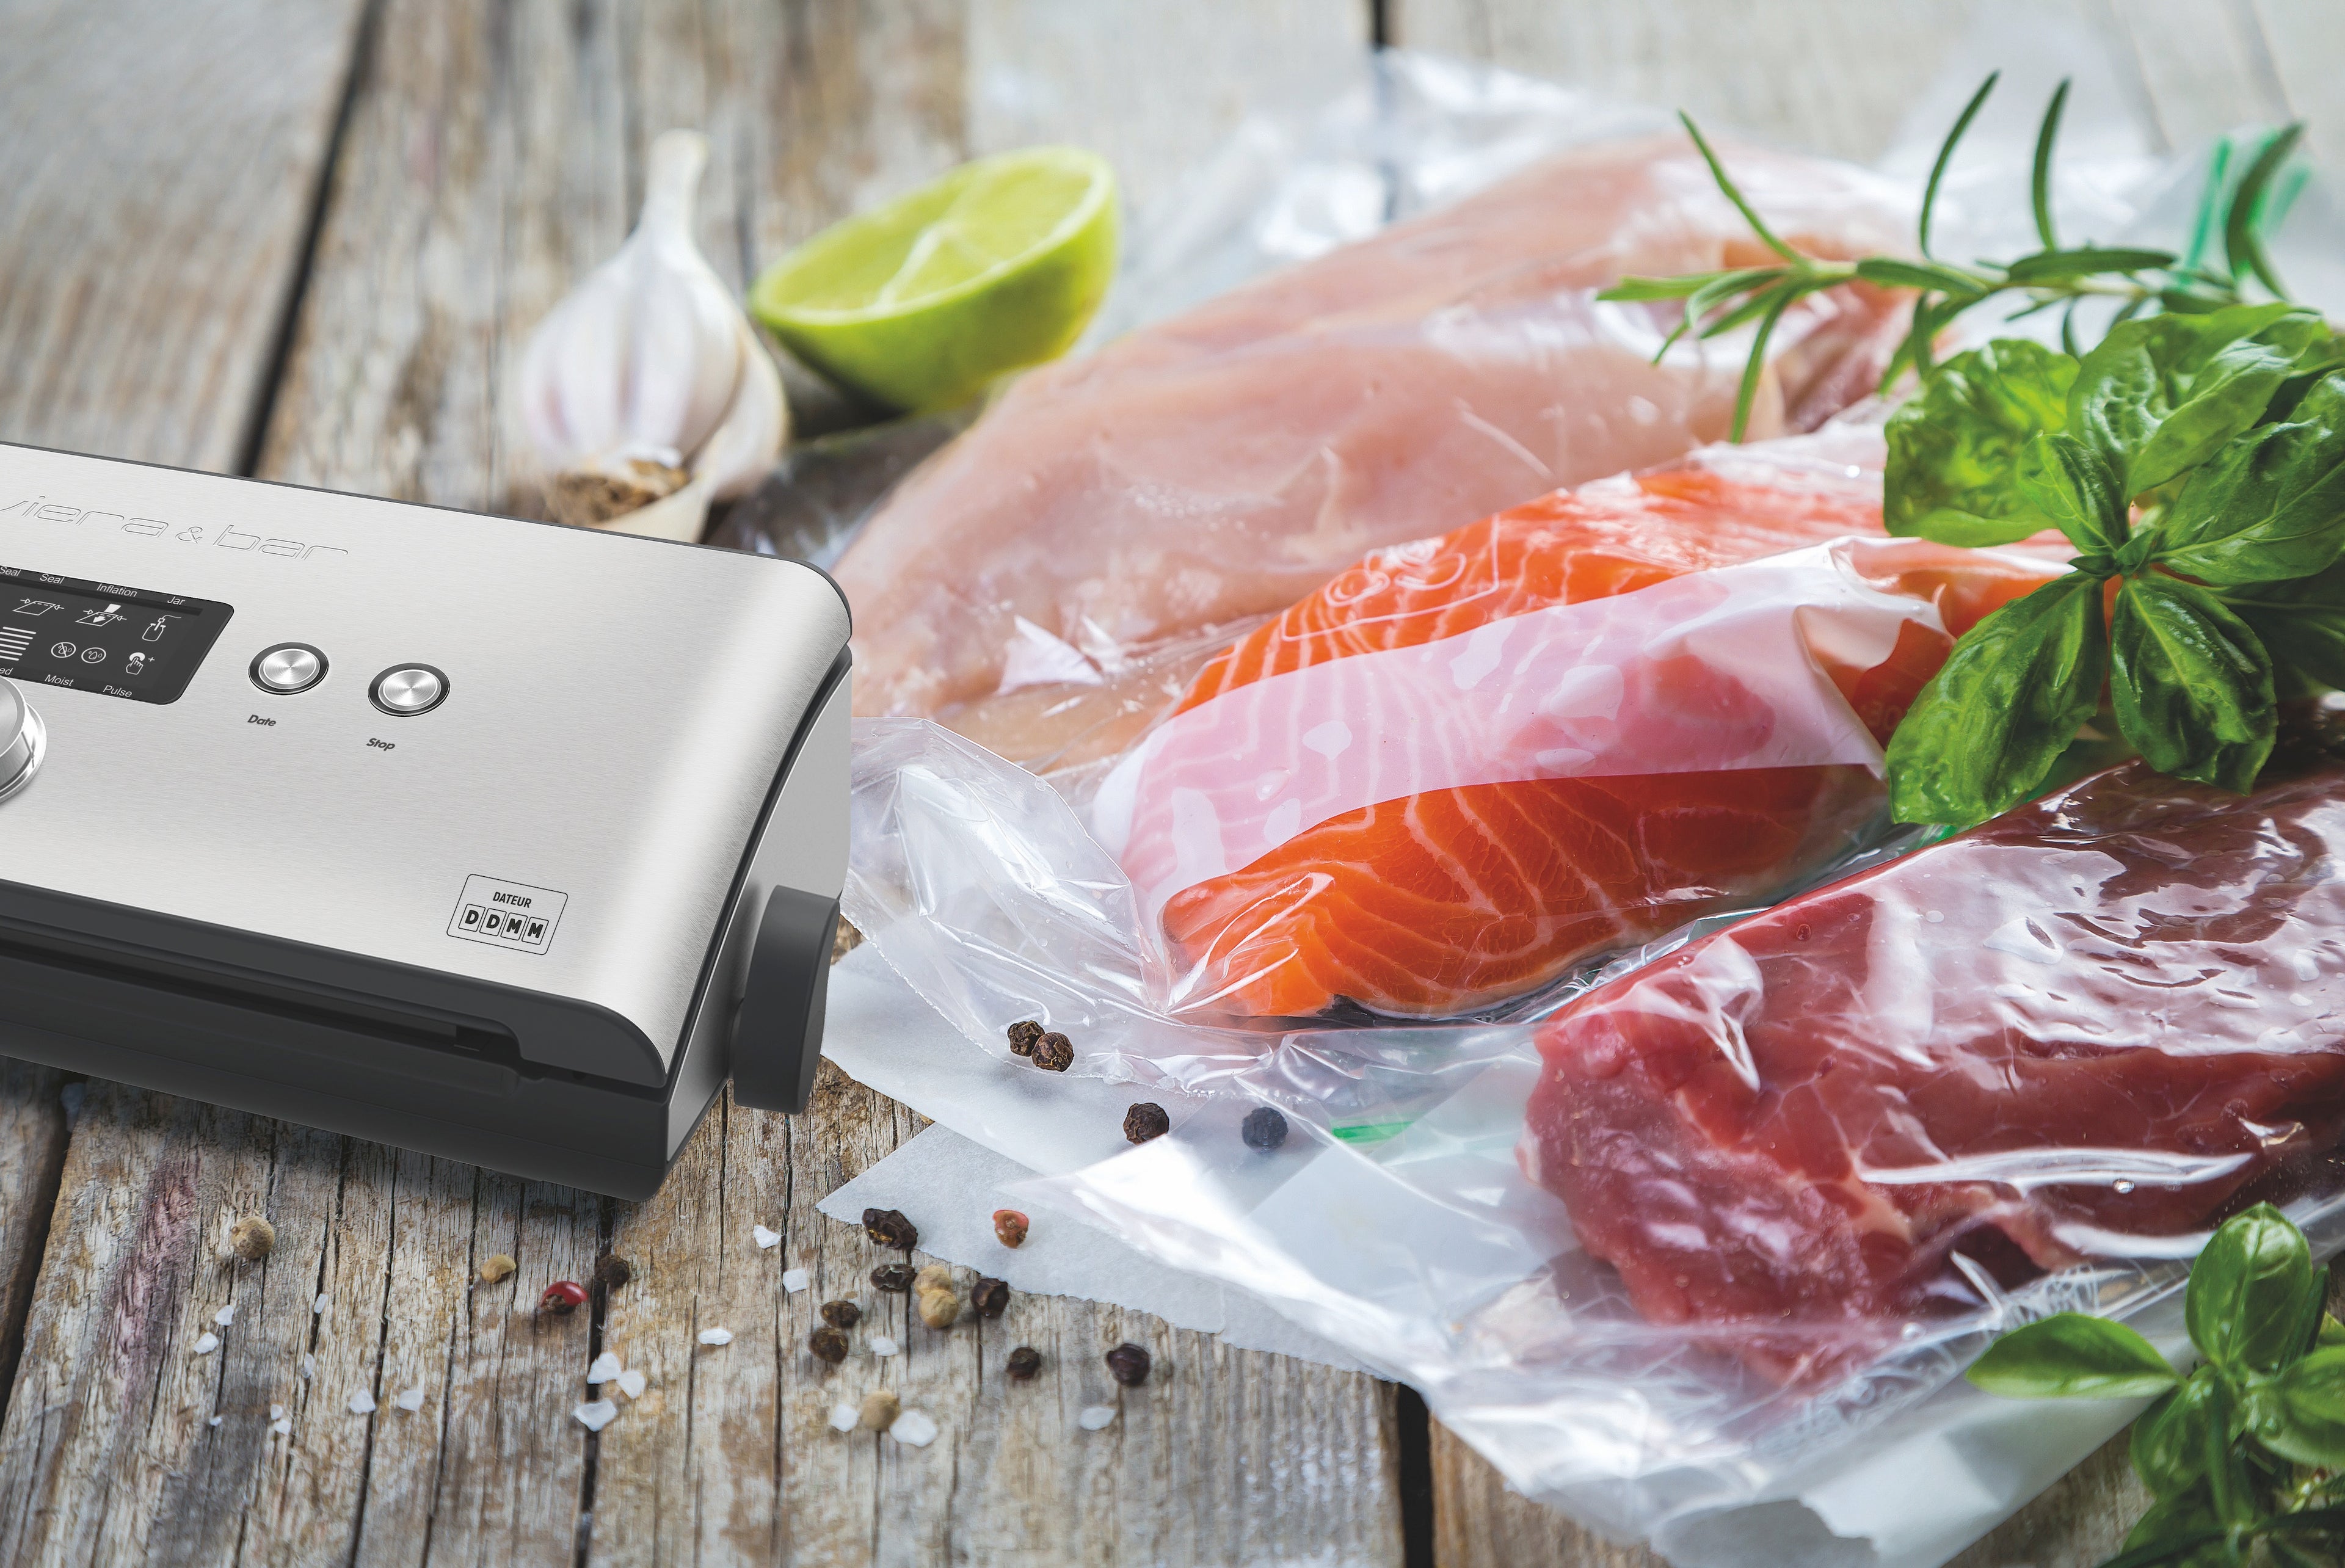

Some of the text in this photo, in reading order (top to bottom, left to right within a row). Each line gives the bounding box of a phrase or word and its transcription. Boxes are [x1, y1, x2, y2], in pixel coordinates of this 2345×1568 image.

[175, 526, 203, 545] &
[213, 524, 349, 561] bar
[0, 566, 21, 576] Seal
[40, 573, 65, 584] Seal
[96, 583, 138, 598] Inflation
[167, 596, 186, 606] Jar
[44, 673, 74, 686] Moist
[103, 684, 133, 698] Pulse
[247, 714, 277, 727] Date
[366, 738, 396, 752] Stop
[492, 891, 532, 909] DATEUR
